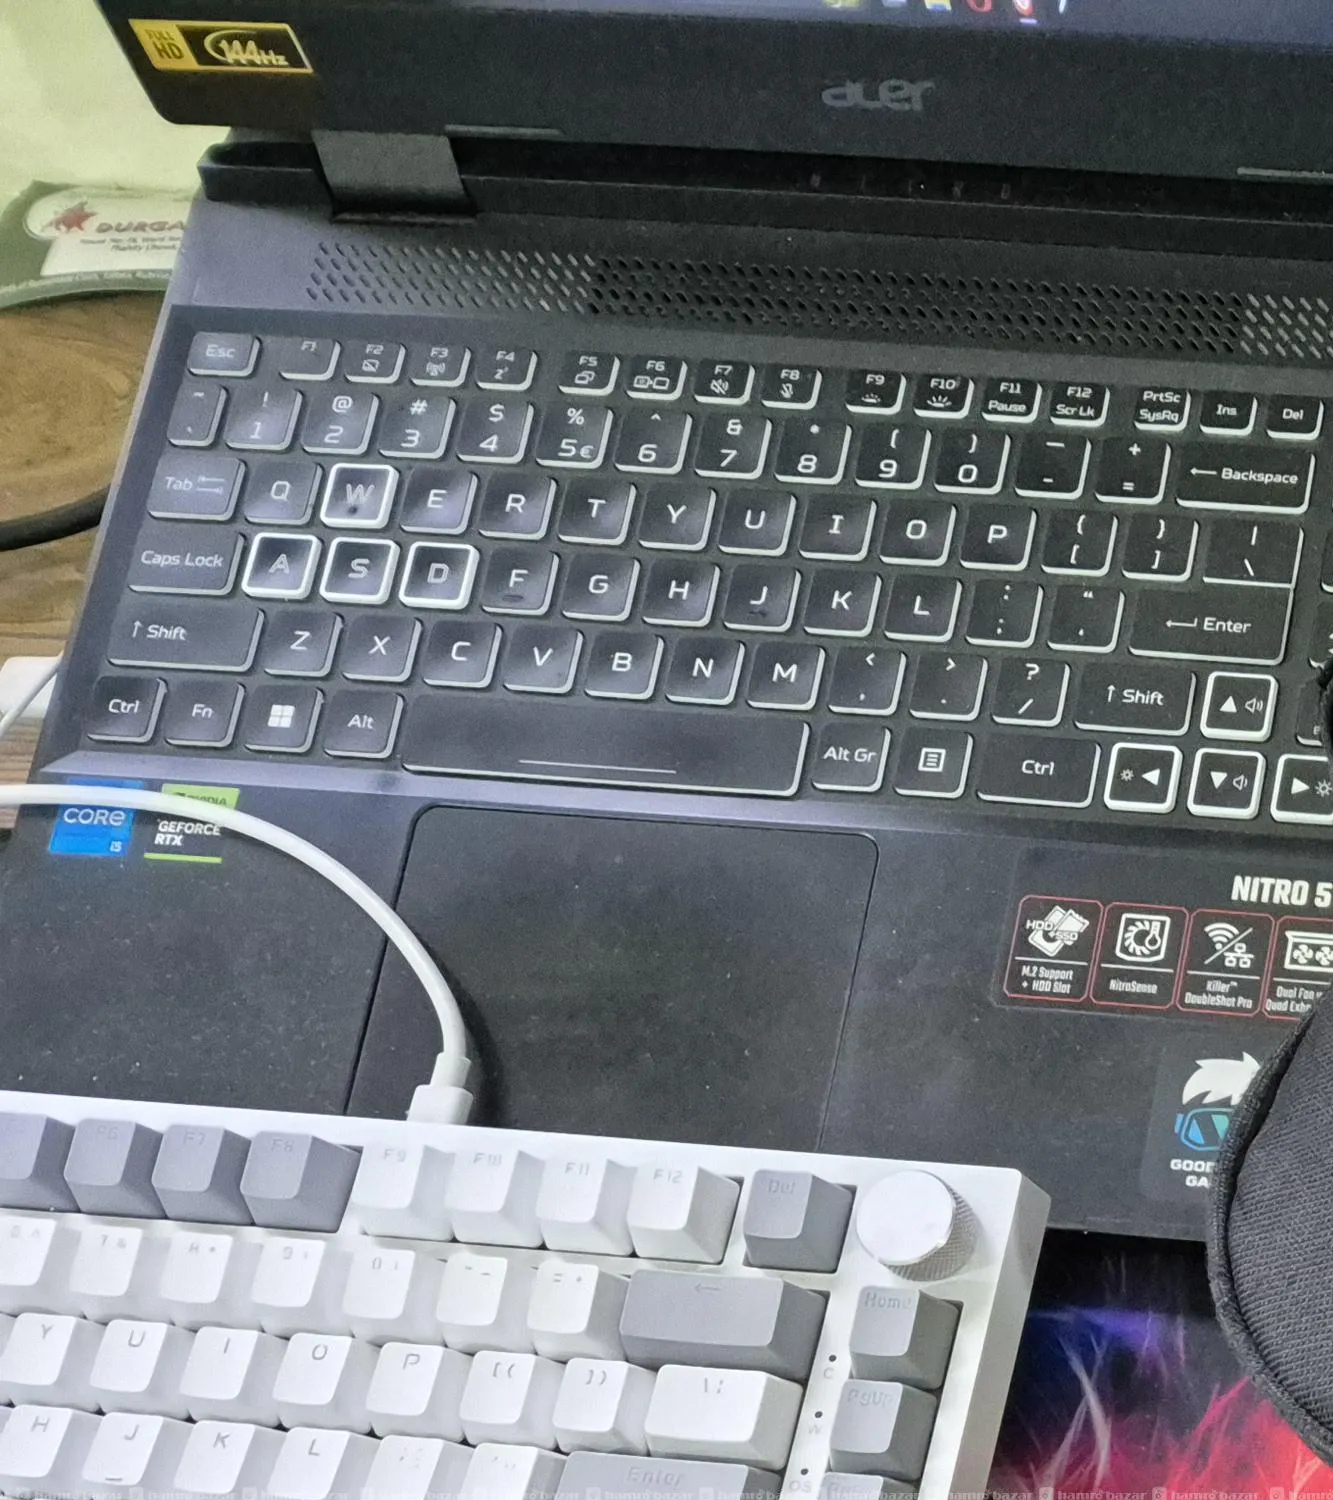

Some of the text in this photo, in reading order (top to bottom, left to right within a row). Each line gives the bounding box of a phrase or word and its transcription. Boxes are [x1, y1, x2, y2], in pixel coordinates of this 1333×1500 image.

[153, 41, 185, 60] HD
[821, 76, 935, 112] acer
[206, 345, 236, 359] Esc
[1143, 391, 1180, 403] PrtSc
[988, 400, 1026, 413] Pause
[1217, 404, 1237, 416] Ins
[1282, 407, 1304, 420] Del
[165, 476, 192, 491] Tab
[1220, 468, 1298, 485] Backspace
[271, 481, 290, 500] Q
[346, 483, 374, 501] W
[428, 489, 447, 508] E
[505, 494, 525, 513] R
[588, 498, 605, 518] T
[667, 504, 687, 524] Y
[745, 509, 765, 529] U
[828, 515, 844, 534] I
[906, 520, 927, 538] O
[987, 525, 1008, 543] P
[141, 550, 223, 568] Caps Lock
[268, 554, 290, 574] A
[348, 559, 370, 578] S
[427, 563, 449, 583] D
[509, 569, 528, 588] F
[588, 575, 608, 594] G
[668, 581, 689, 600] H
[750, 586, 768, 605] J
[831, 591, 852, 610] K
[913, 597, 930, 615] L
[146, 624, 187, 641] Shift
[1203, 617, 1251, 634] Enter
[290, 631, 310, 650] Z
[368, 636, 390, 655] X
[451, 642, 471, 661] C
[532, 647, 553, 666] V
[612, 653, 632, 672] B
[692, 659, 713, 678] N
[771, 663, 798, 683] M
[108, 698, 140, 714] Ctrl
[1122, 688, 1165, 707] Shift
[192, 705, 213, 718] Fn
[347, 713, 374, 729] Alt
[824, 746, 876, 763] Alt Gr
[1022, 759, 1054, 776] Ctrl
[158, 820, 221, 836] GEFORCE
[155, 833, 183, 846] RTX
[1231, 874, 1333, 908] NITRO 5
[1025, 919, 1054, 930] HDD
[1021, 965, 1073, 981] M.2 Support
[1032, 980, 1052, 992] HDD
[1109, 978, 1158, 994] NitroSense
[1276, 986, 1297, 999] Dual
[1184, 992, 1236, 1007] DoubleShot
